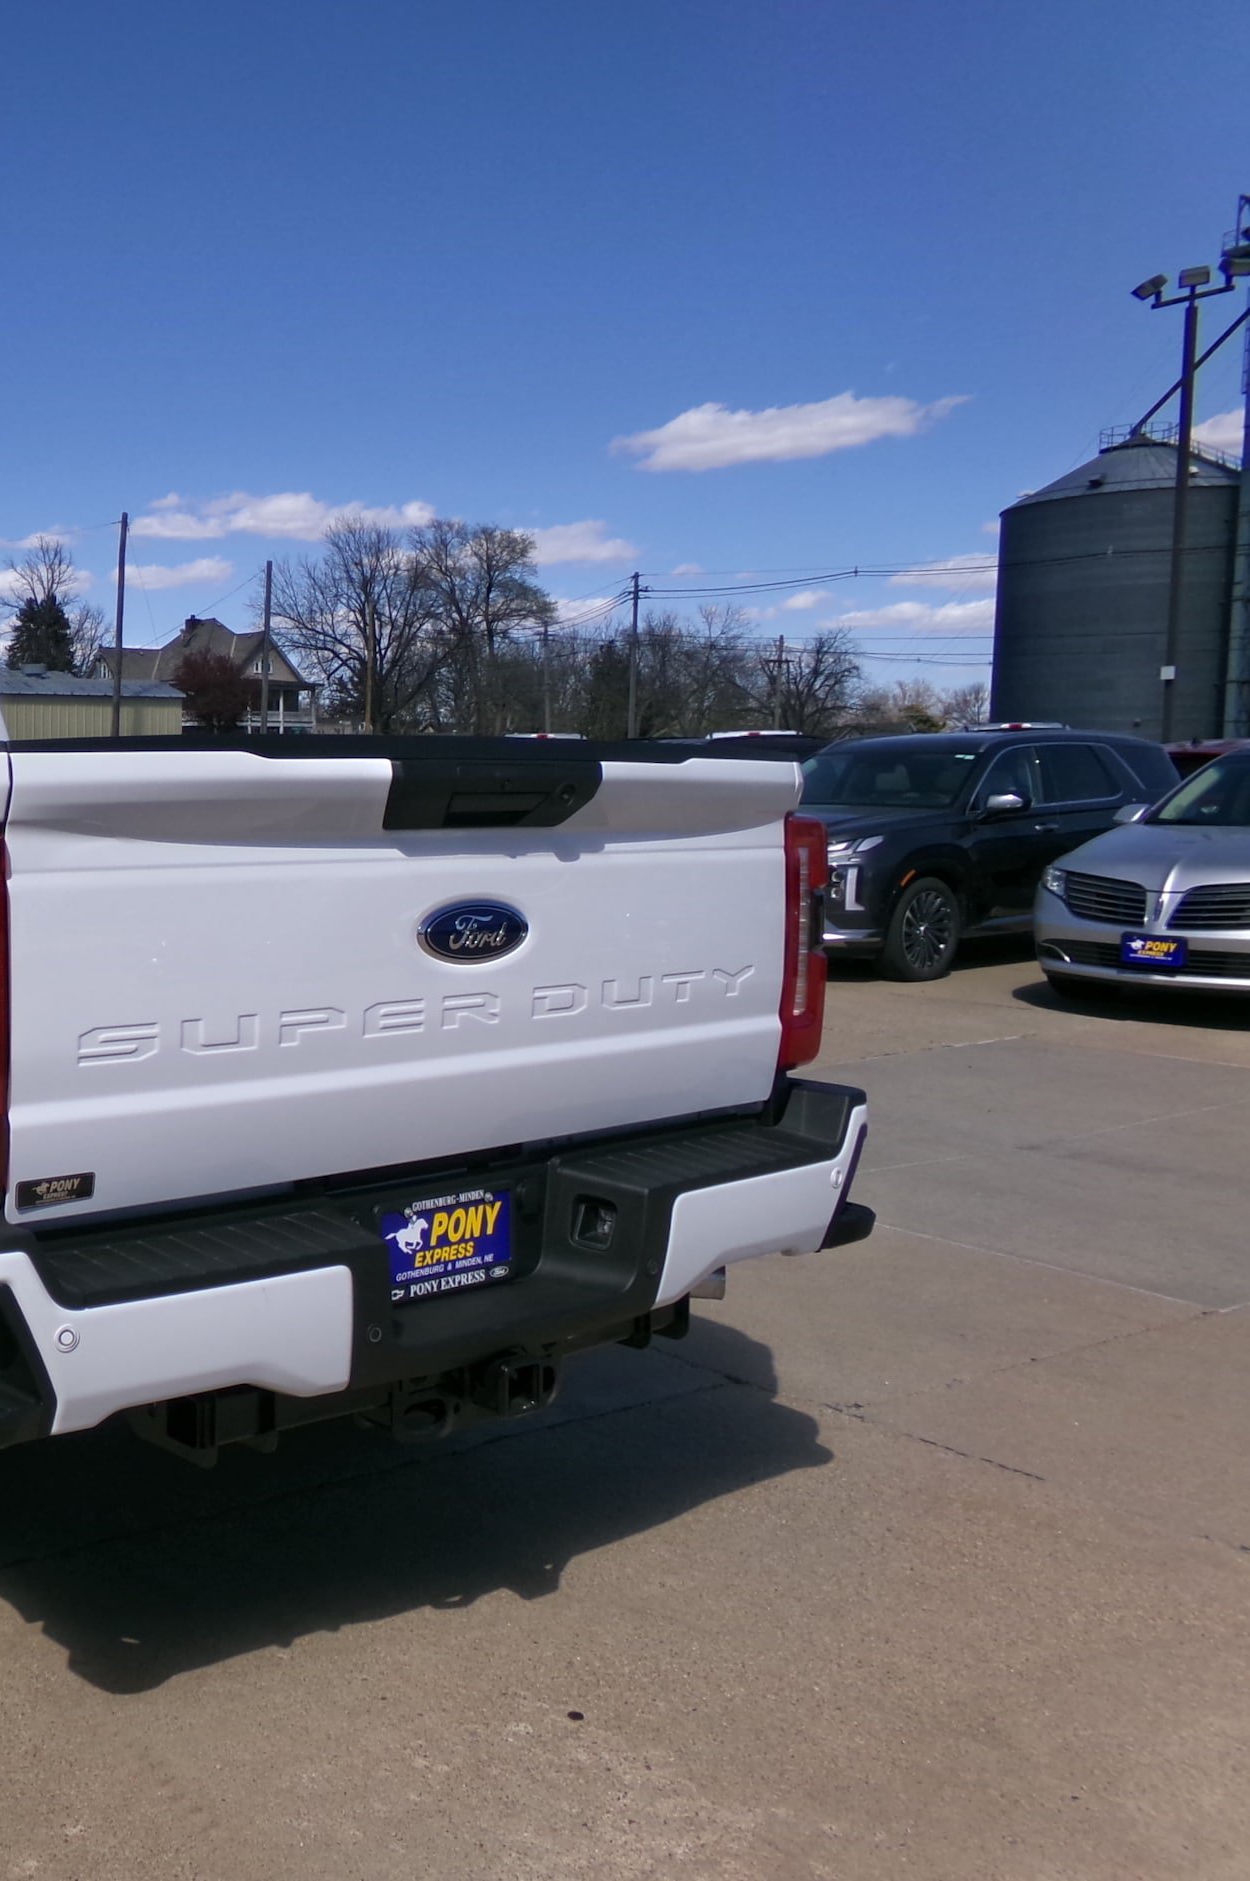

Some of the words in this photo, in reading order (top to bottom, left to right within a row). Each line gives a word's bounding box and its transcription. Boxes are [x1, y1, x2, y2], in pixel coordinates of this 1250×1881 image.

[448, 914, 507, 950] Ford
[1144, 940, 1178, 953] PONY
[76, 991, 503, 1068] SUPER
[530, 963, 756, 1020] DUTY
[49, 1177, 82, 1193] PONY
[429, 1201, 502, 1247] PONY
[395, 1263, 445, 1282] GOTHENBURG
[483, 1253, 495, 1263] NE
[414, 1241, 475, 1268] EXPRESS
[409, 1278, 442, 1298] PONY
[440, 1269, 486, 1290] EXPRESS
